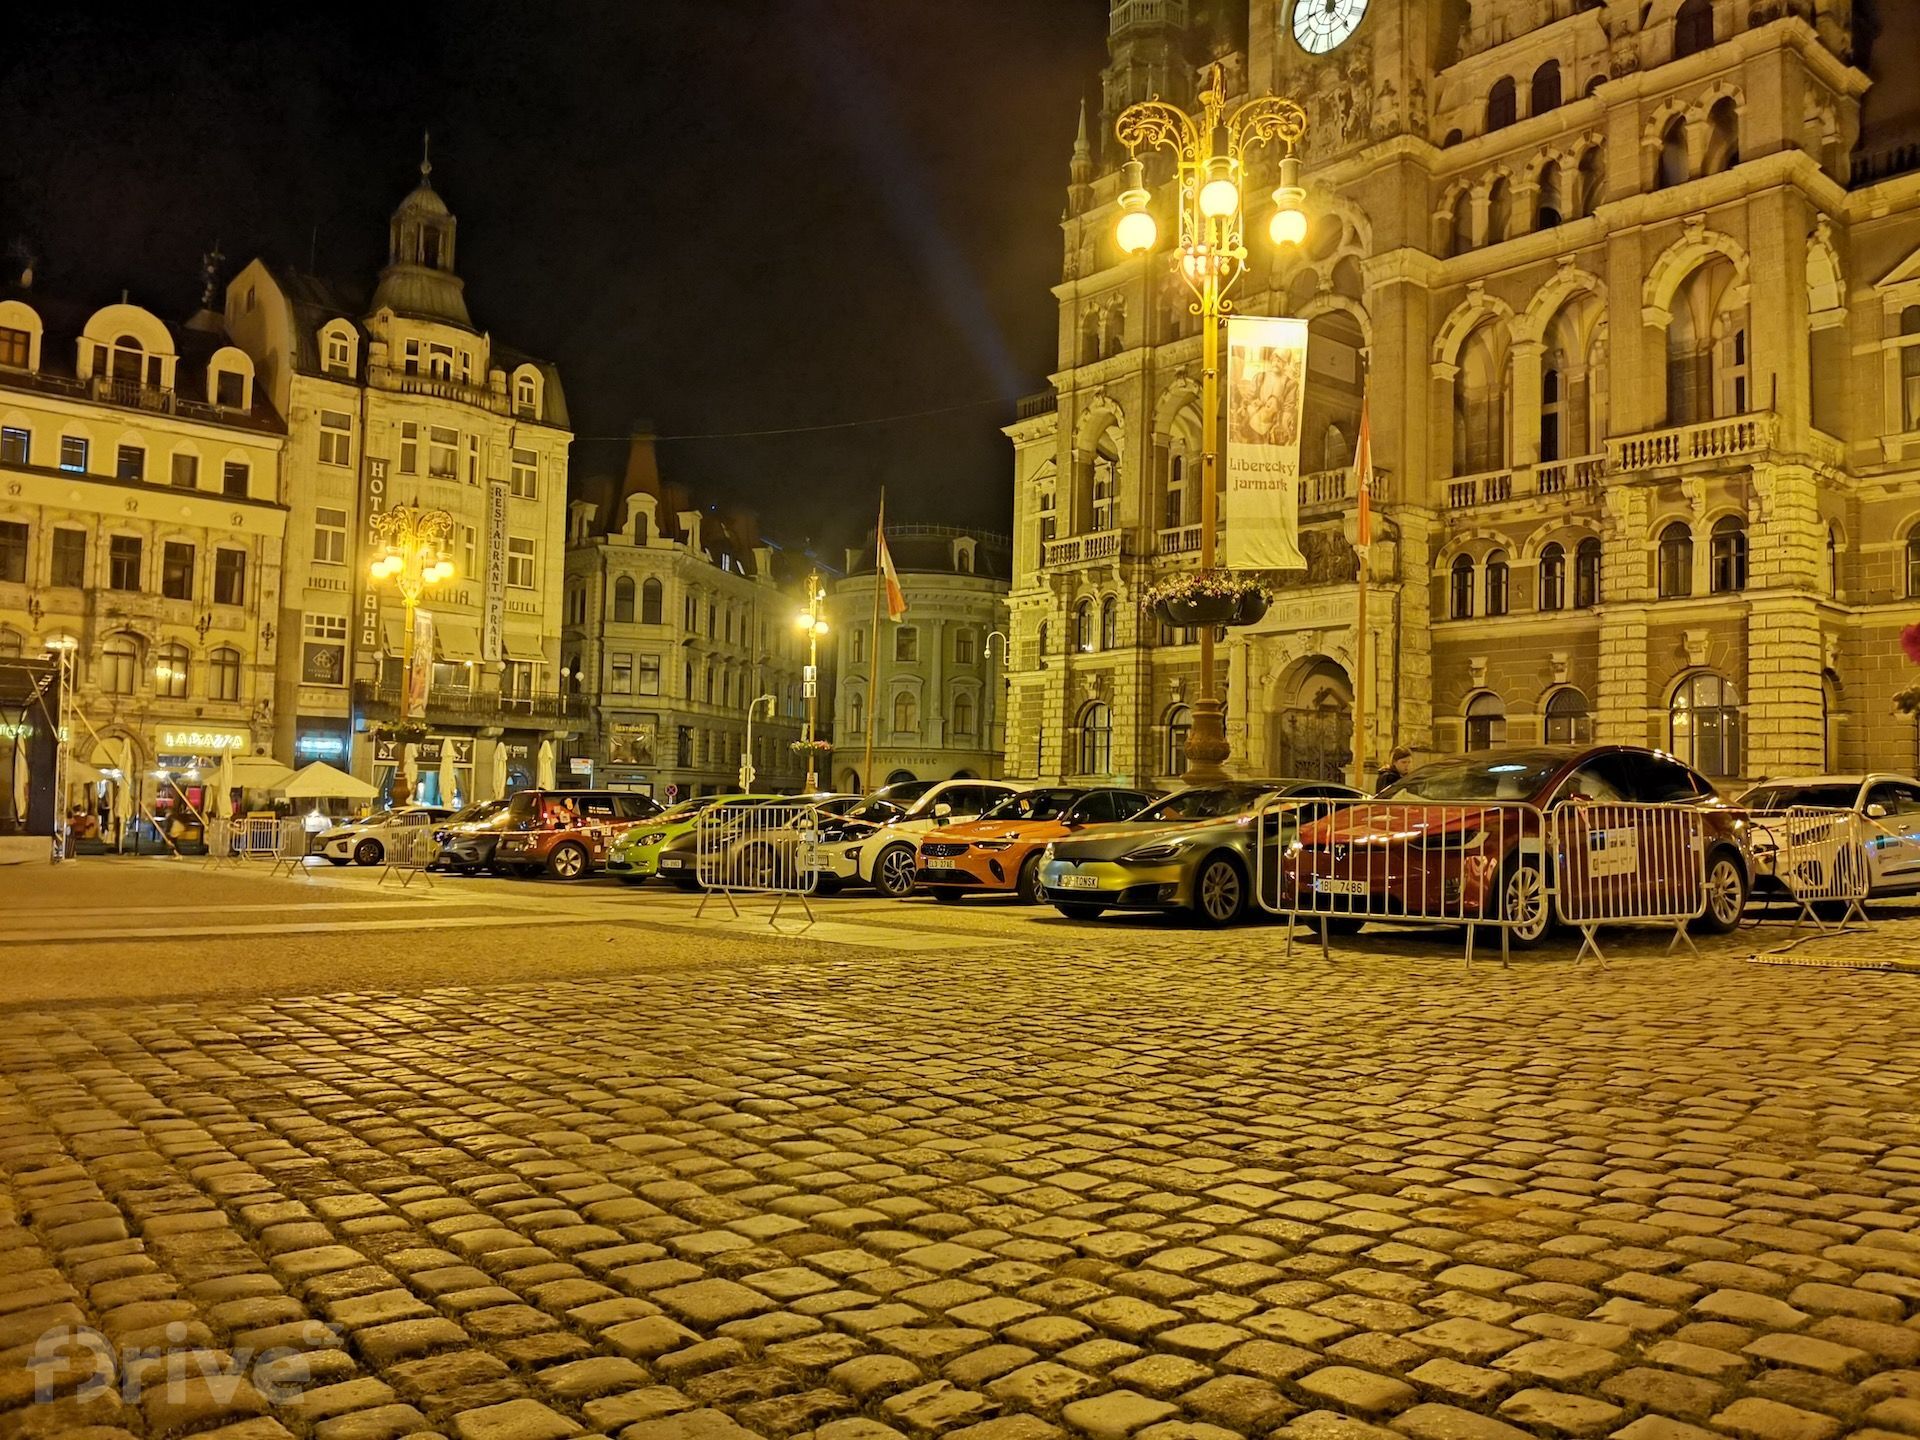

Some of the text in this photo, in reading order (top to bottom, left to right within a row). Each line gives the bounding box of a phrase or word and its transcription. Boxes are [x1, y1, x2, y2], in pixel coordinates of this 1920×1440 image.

[1229, 458, 1296, 477] Liberecký
[1233, 476, 1288, 492] jarmark
[368, 462, 384, 546] HOTEL
[491, 487, 502, 593] RESTAURANT
[308, 576, 347, 591] HOTEL
[1340, 881, 1363, 894] 7486
